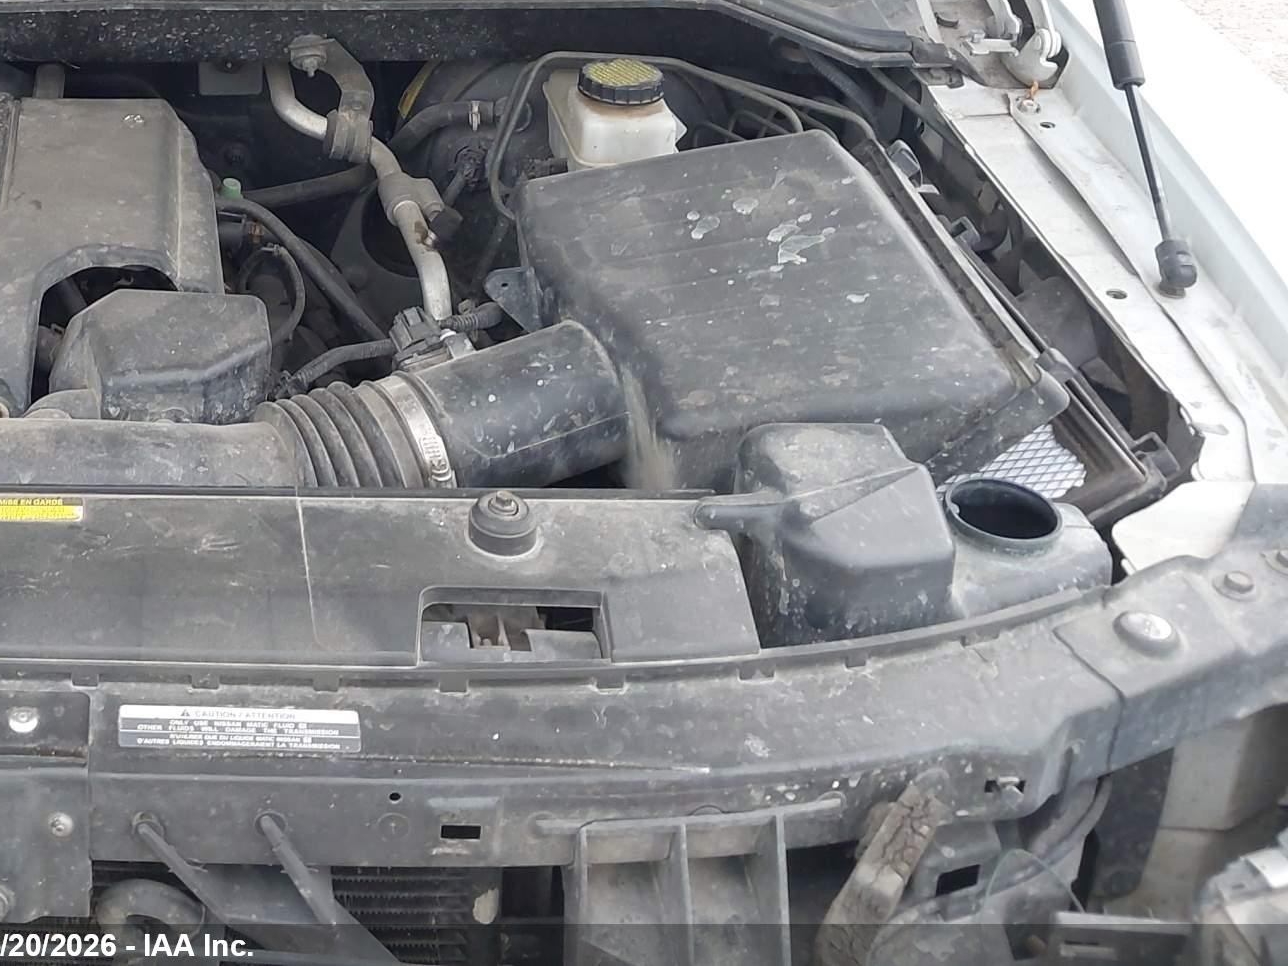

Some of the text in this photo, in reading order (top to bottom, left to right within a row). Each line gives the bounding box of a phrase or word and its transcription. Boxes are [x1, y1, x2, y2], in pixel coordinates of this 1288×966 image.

[20, 498, 32, 506] EN
[33, 498, 64, 506] GARDE
[195, 710, 236, 718] CAUTION
[245, 712, 296, 720] ATTENTION
[284, 728, 339, 736] TRANSMISSION
